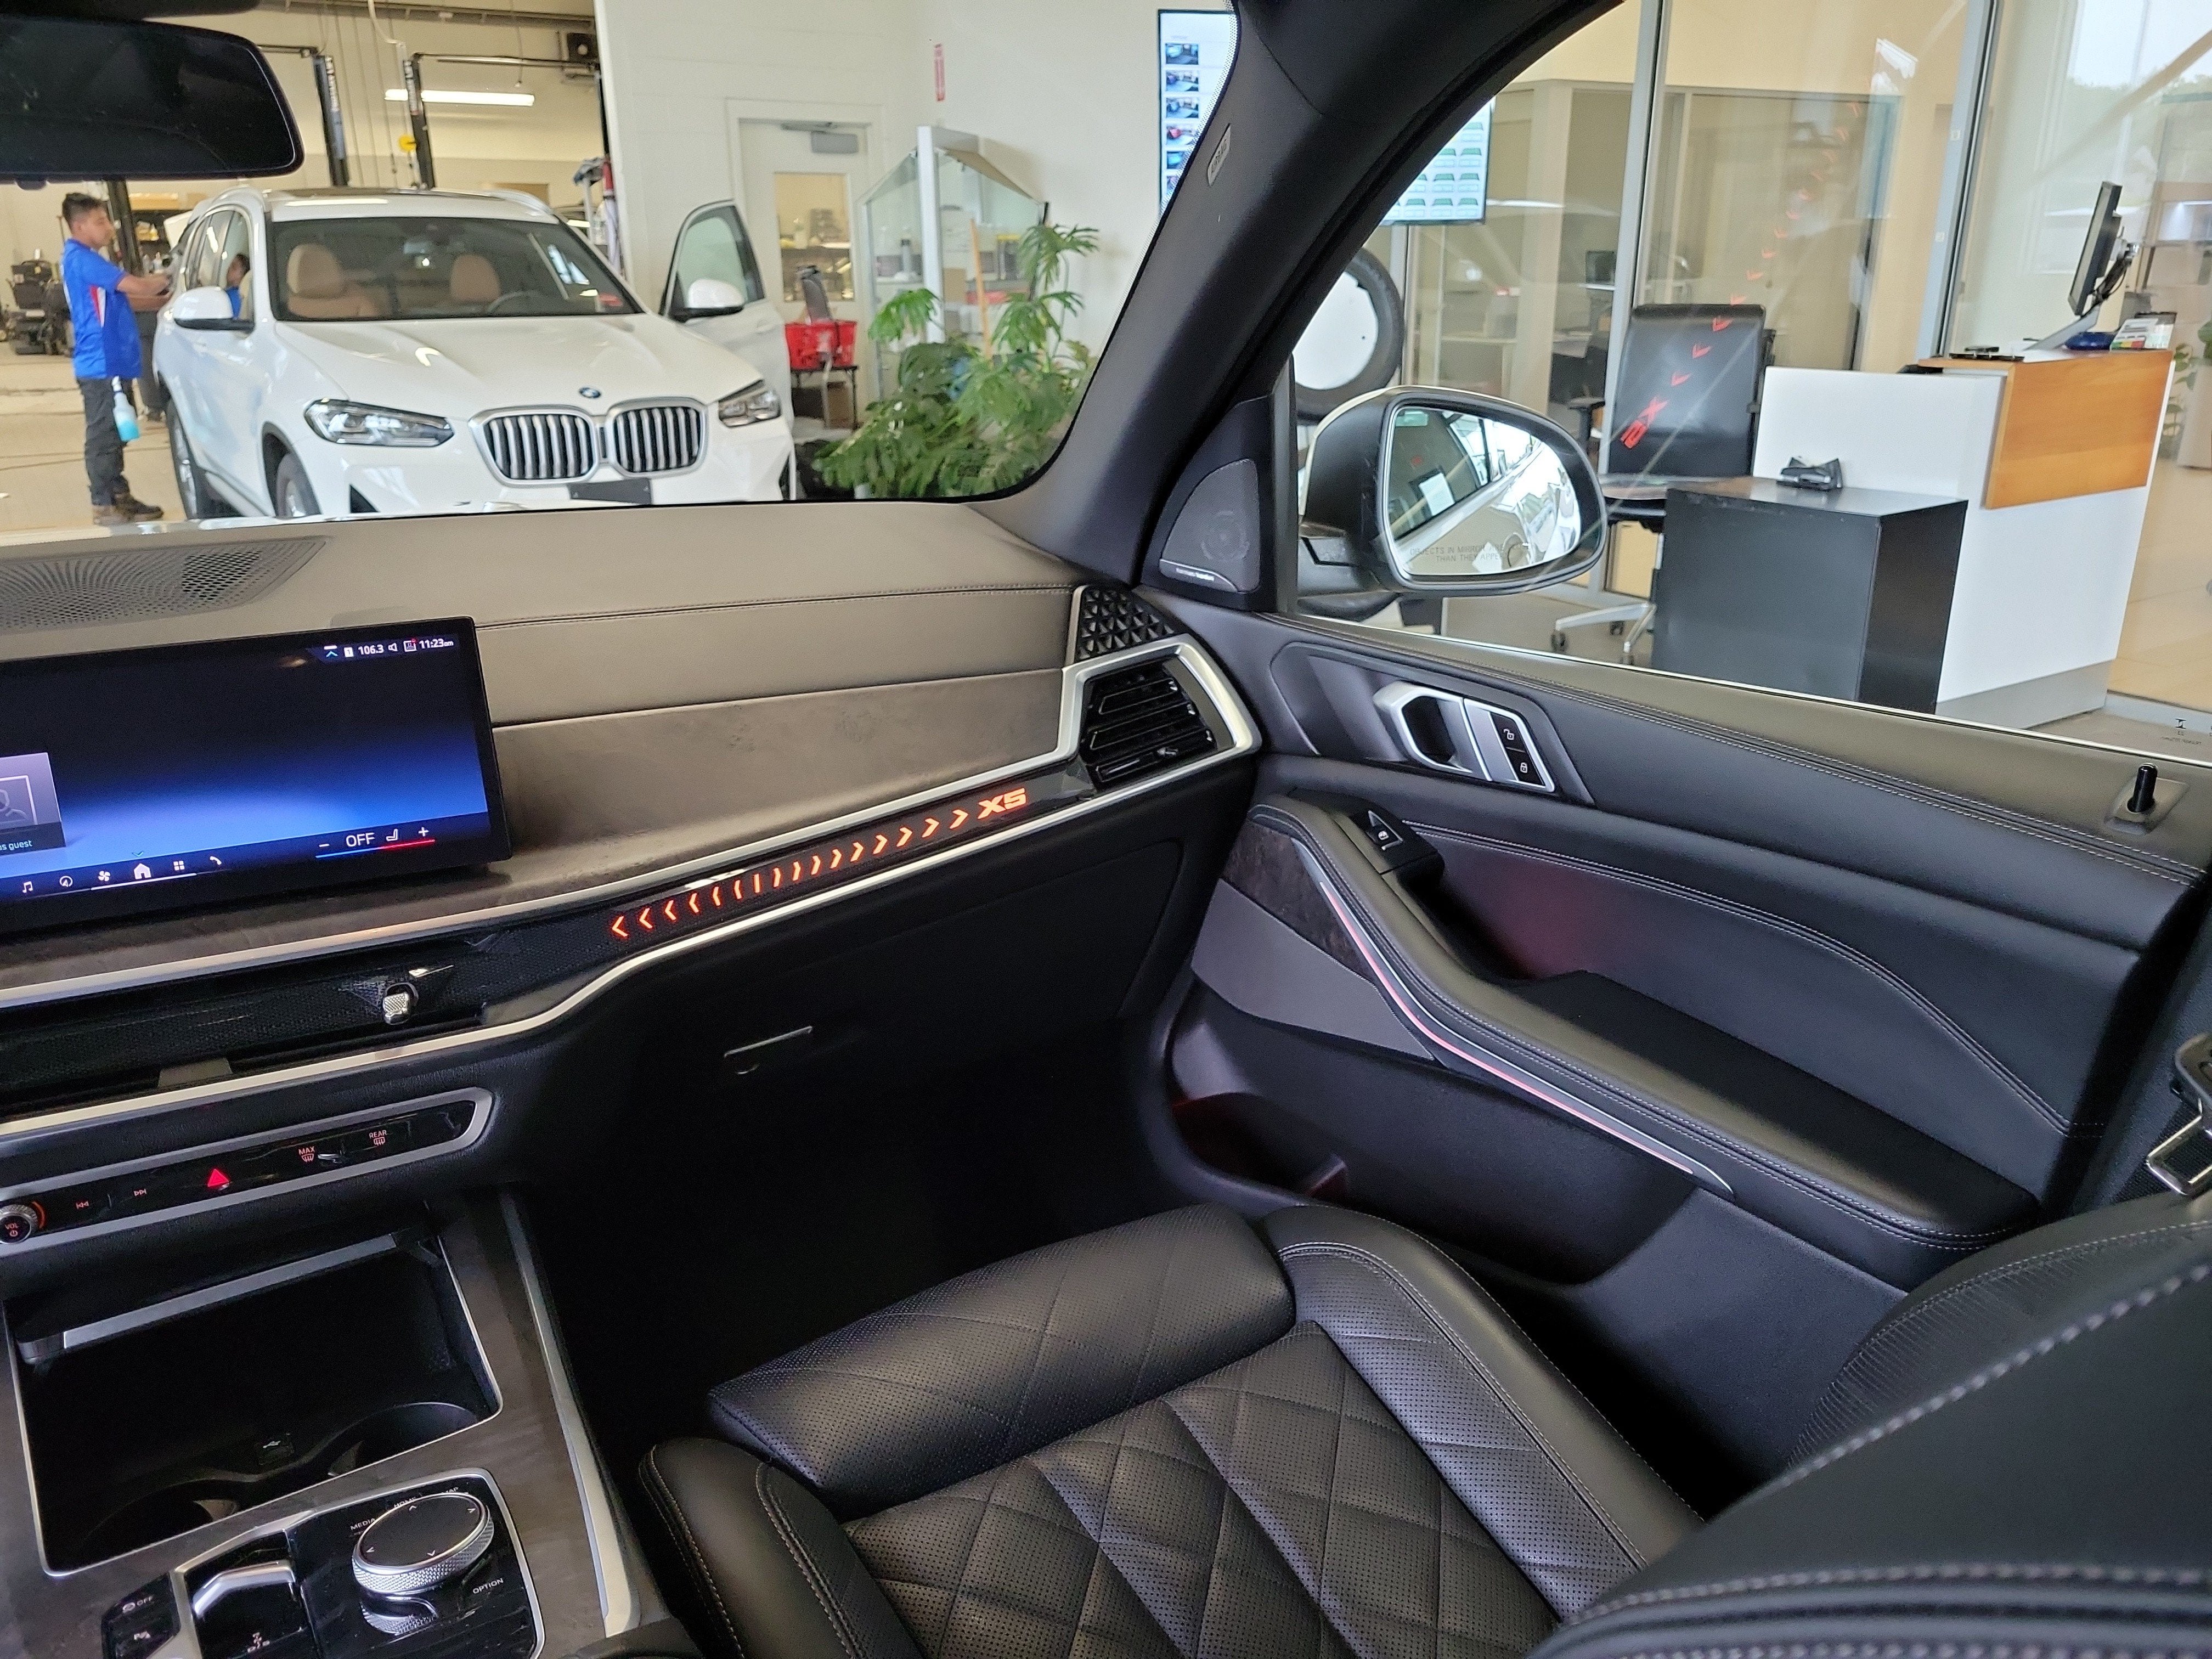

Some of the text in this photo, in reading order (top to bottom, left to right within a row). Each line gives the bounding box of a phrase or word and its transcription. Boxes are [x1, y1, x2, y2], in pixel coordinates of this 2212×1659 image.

[358, 644, 385, 656] 106.3
[977, 787, 1027, 820] X5
[8, 839, 33, 851] guest
[346, 832, 376, 848] OFF
[369, 1129, 387, 1139] REAR
[298, 1146, 315, 1156] MAX
[350, 1517, 376, 1531] MEDIA
[472, 1577, 504, 1594] OPTION
